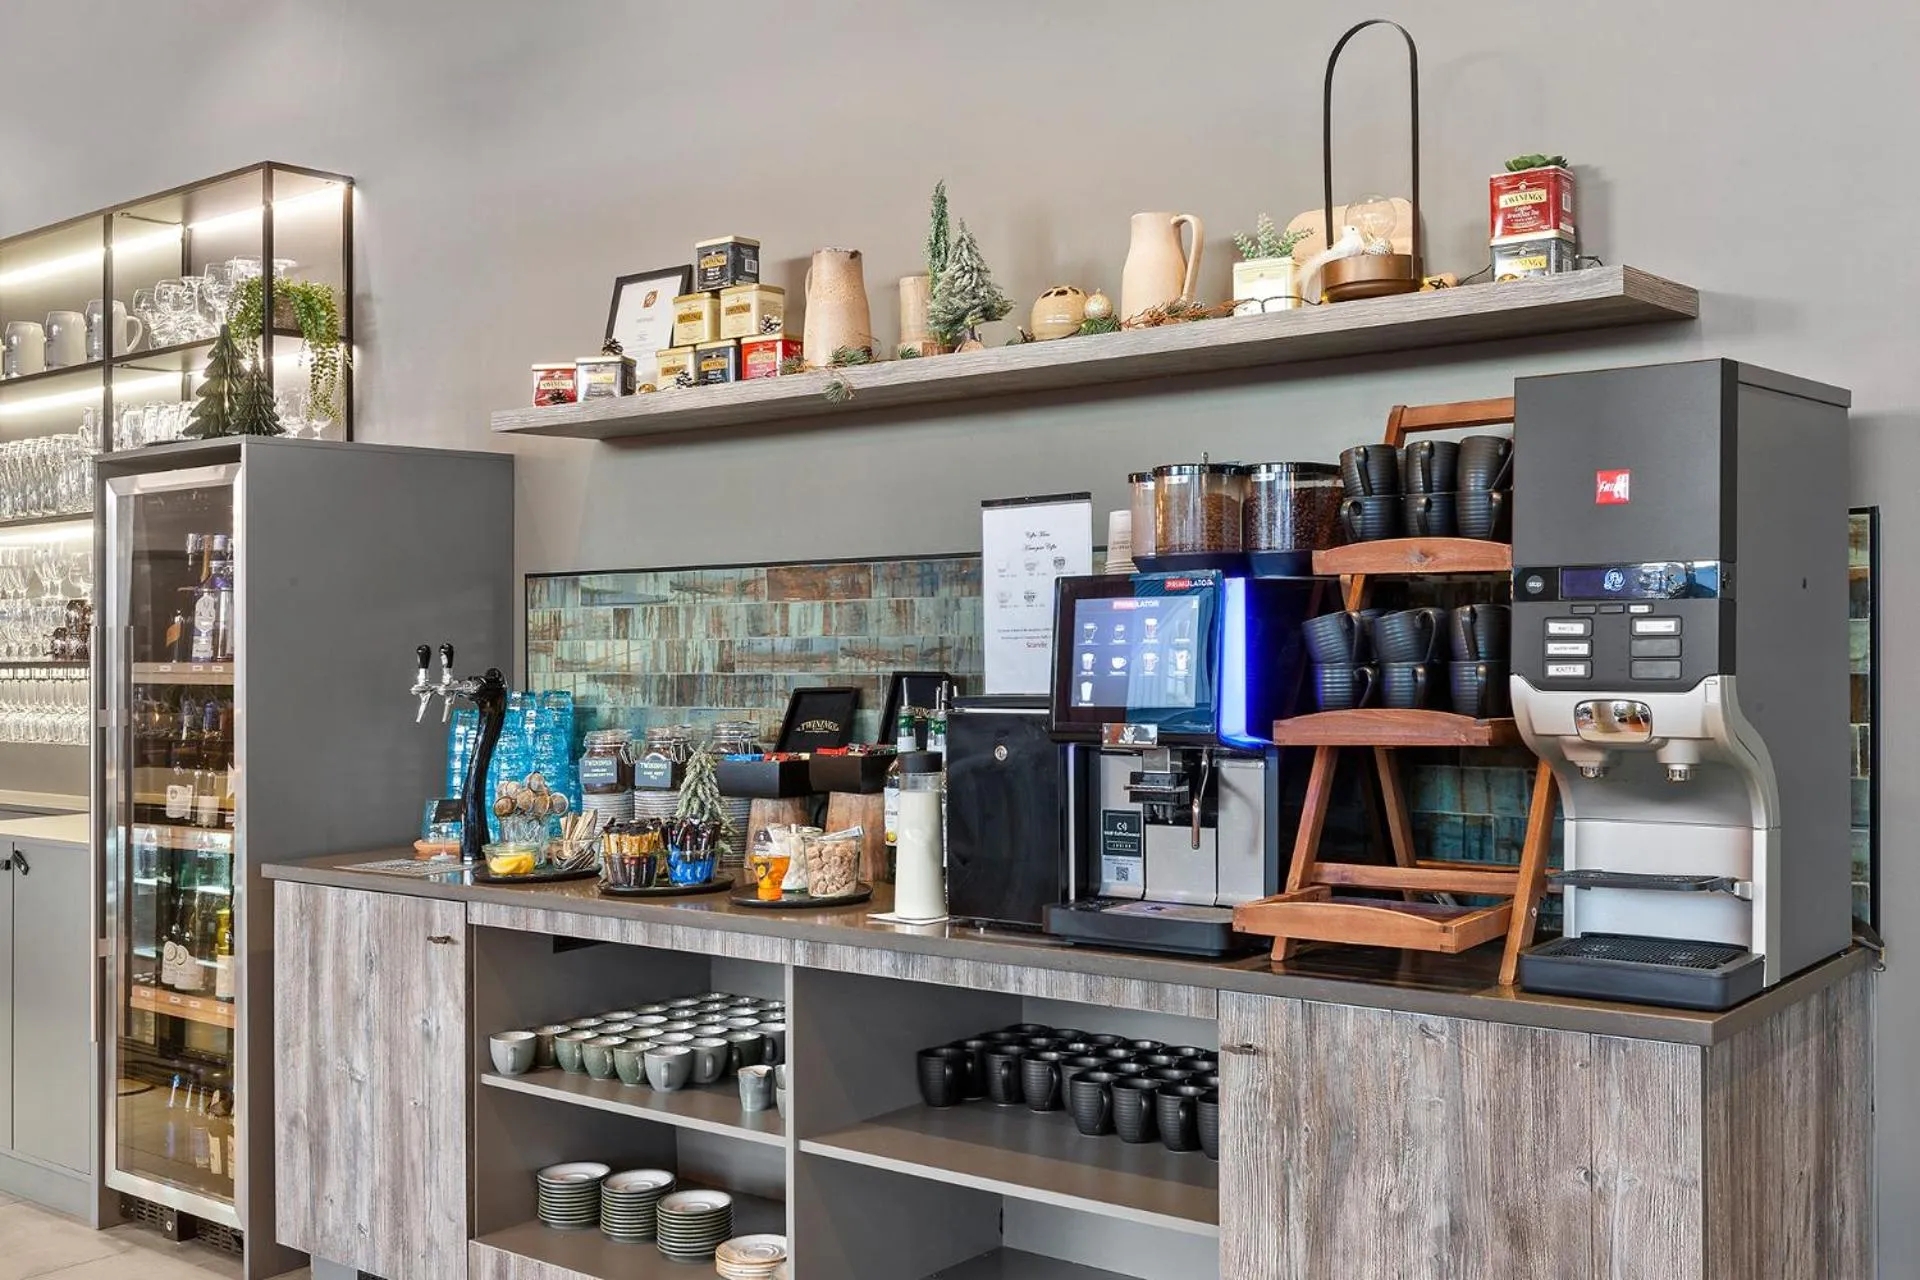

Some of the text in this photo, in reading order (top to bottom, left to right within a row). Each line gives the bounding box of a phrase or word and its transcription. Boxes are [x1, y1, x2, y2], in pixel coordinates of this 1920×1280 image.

[1504, 190, 1544, 206] TWININGS
[1166, 579, 1214, 588] PRIMULATOR
[798, 719, 840, 732] TWININGS
[640, 762, 667, 770] TWININGS
